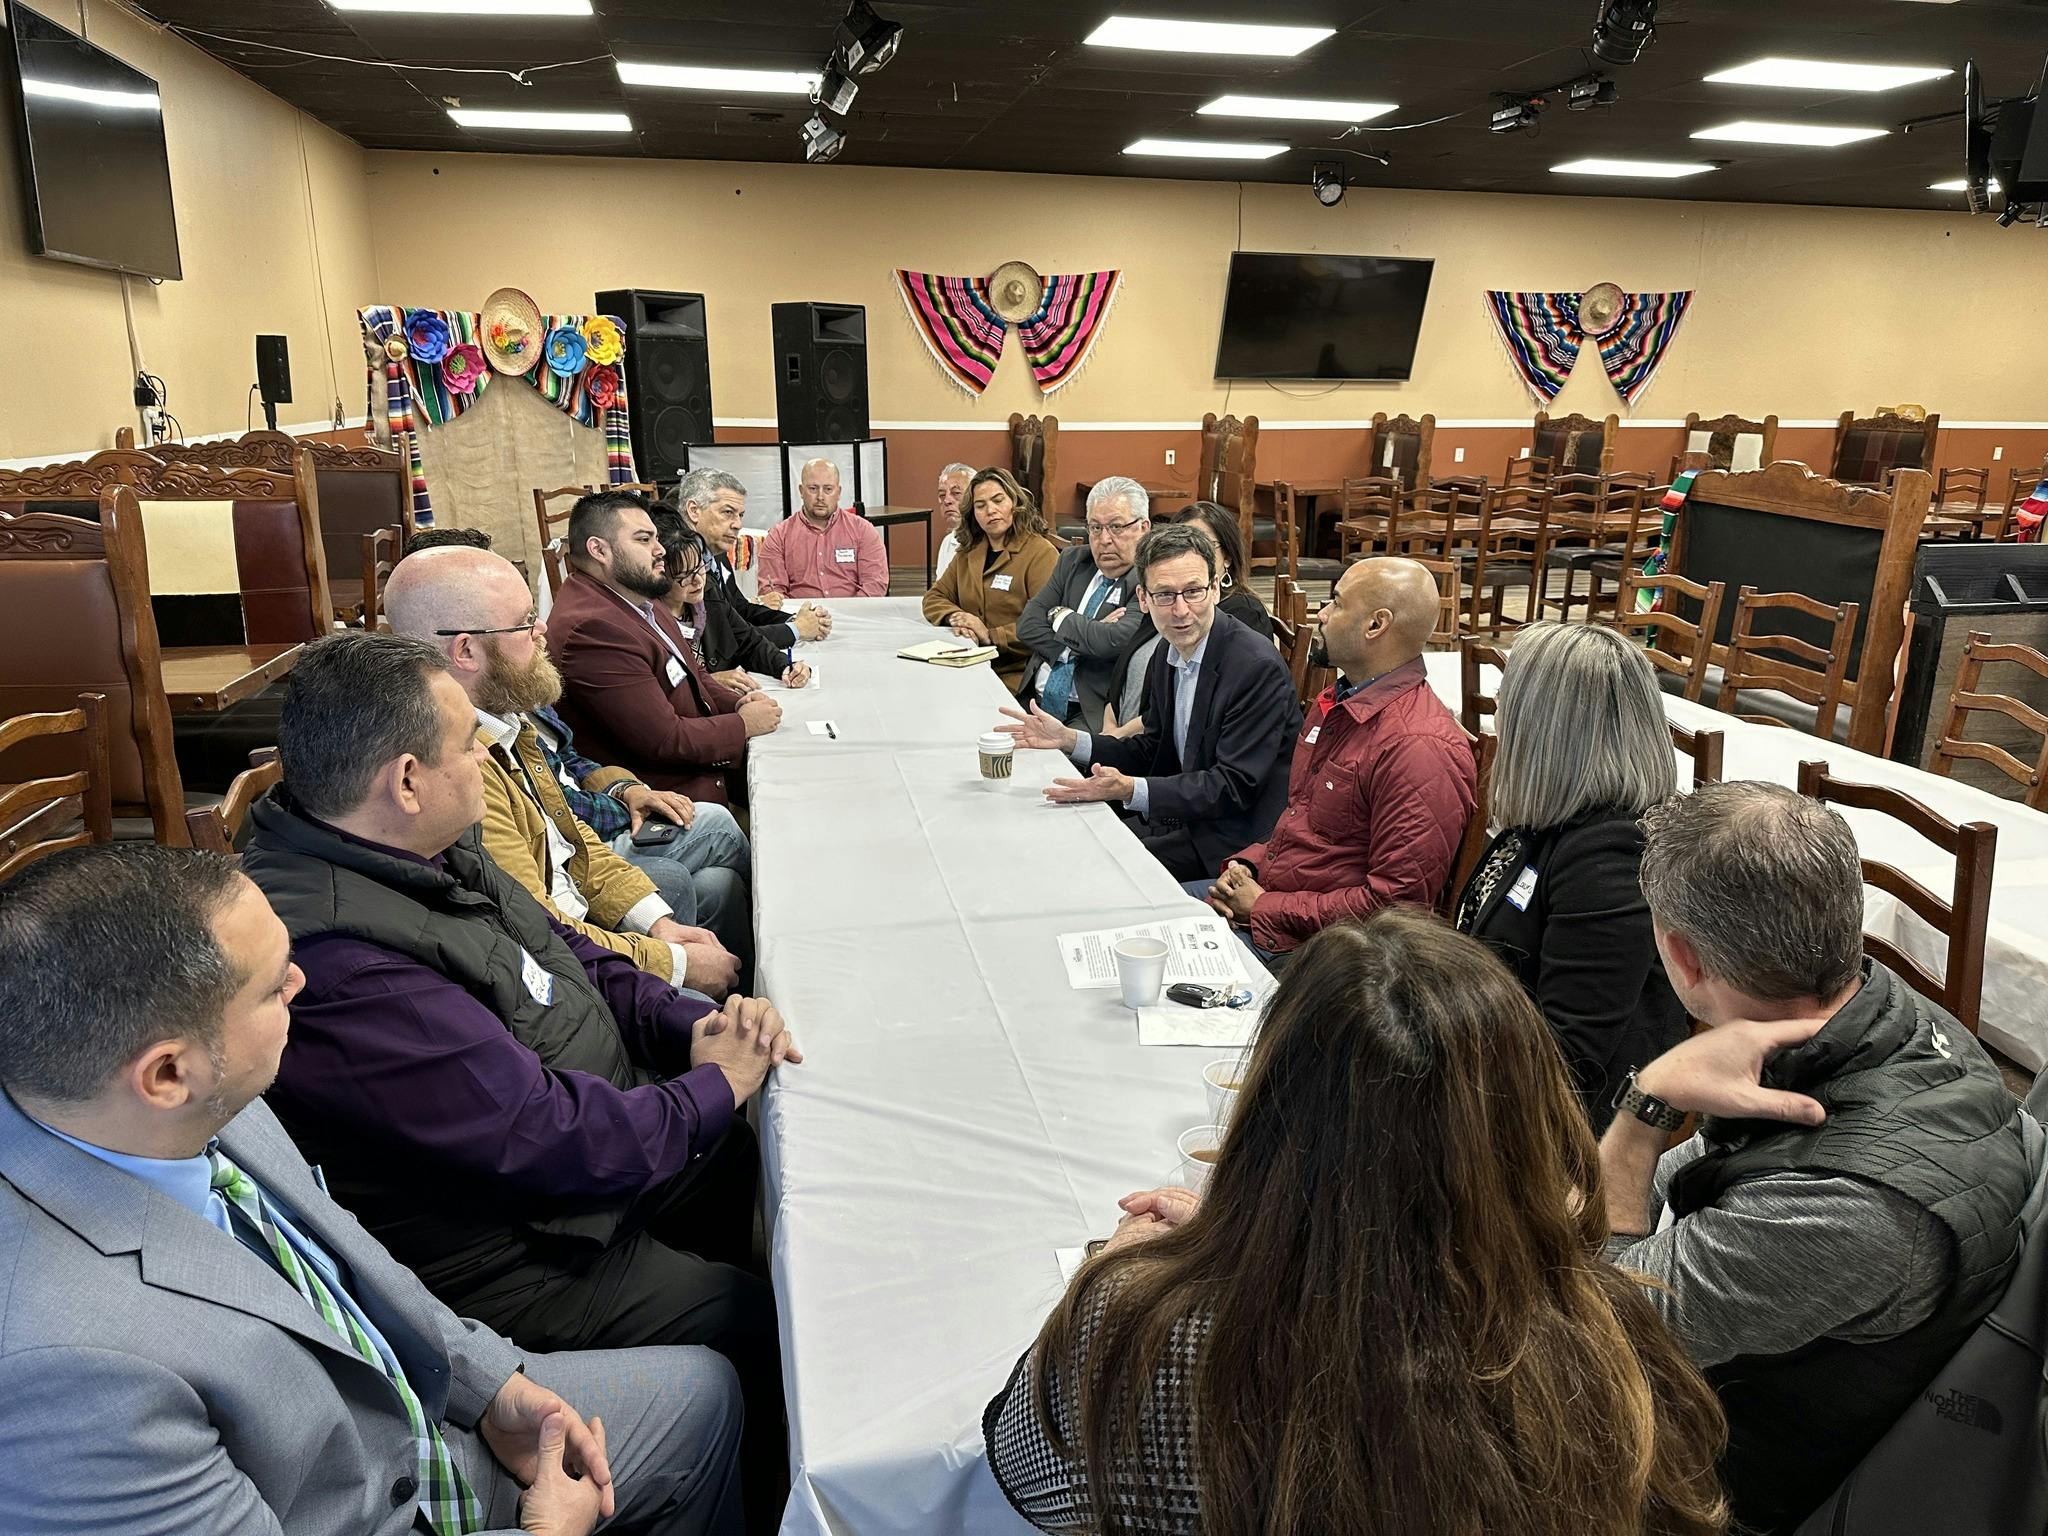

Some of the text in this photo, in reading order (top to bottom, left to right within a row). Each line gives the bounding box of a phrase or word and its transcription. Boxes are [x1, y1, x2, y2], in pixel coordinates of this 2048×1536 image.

[1925, 1390, 1976, 1415] NORTH
[1948, 1388, 1977, 1405] THE
[1936, 1407, 1974, 1426] FACE
